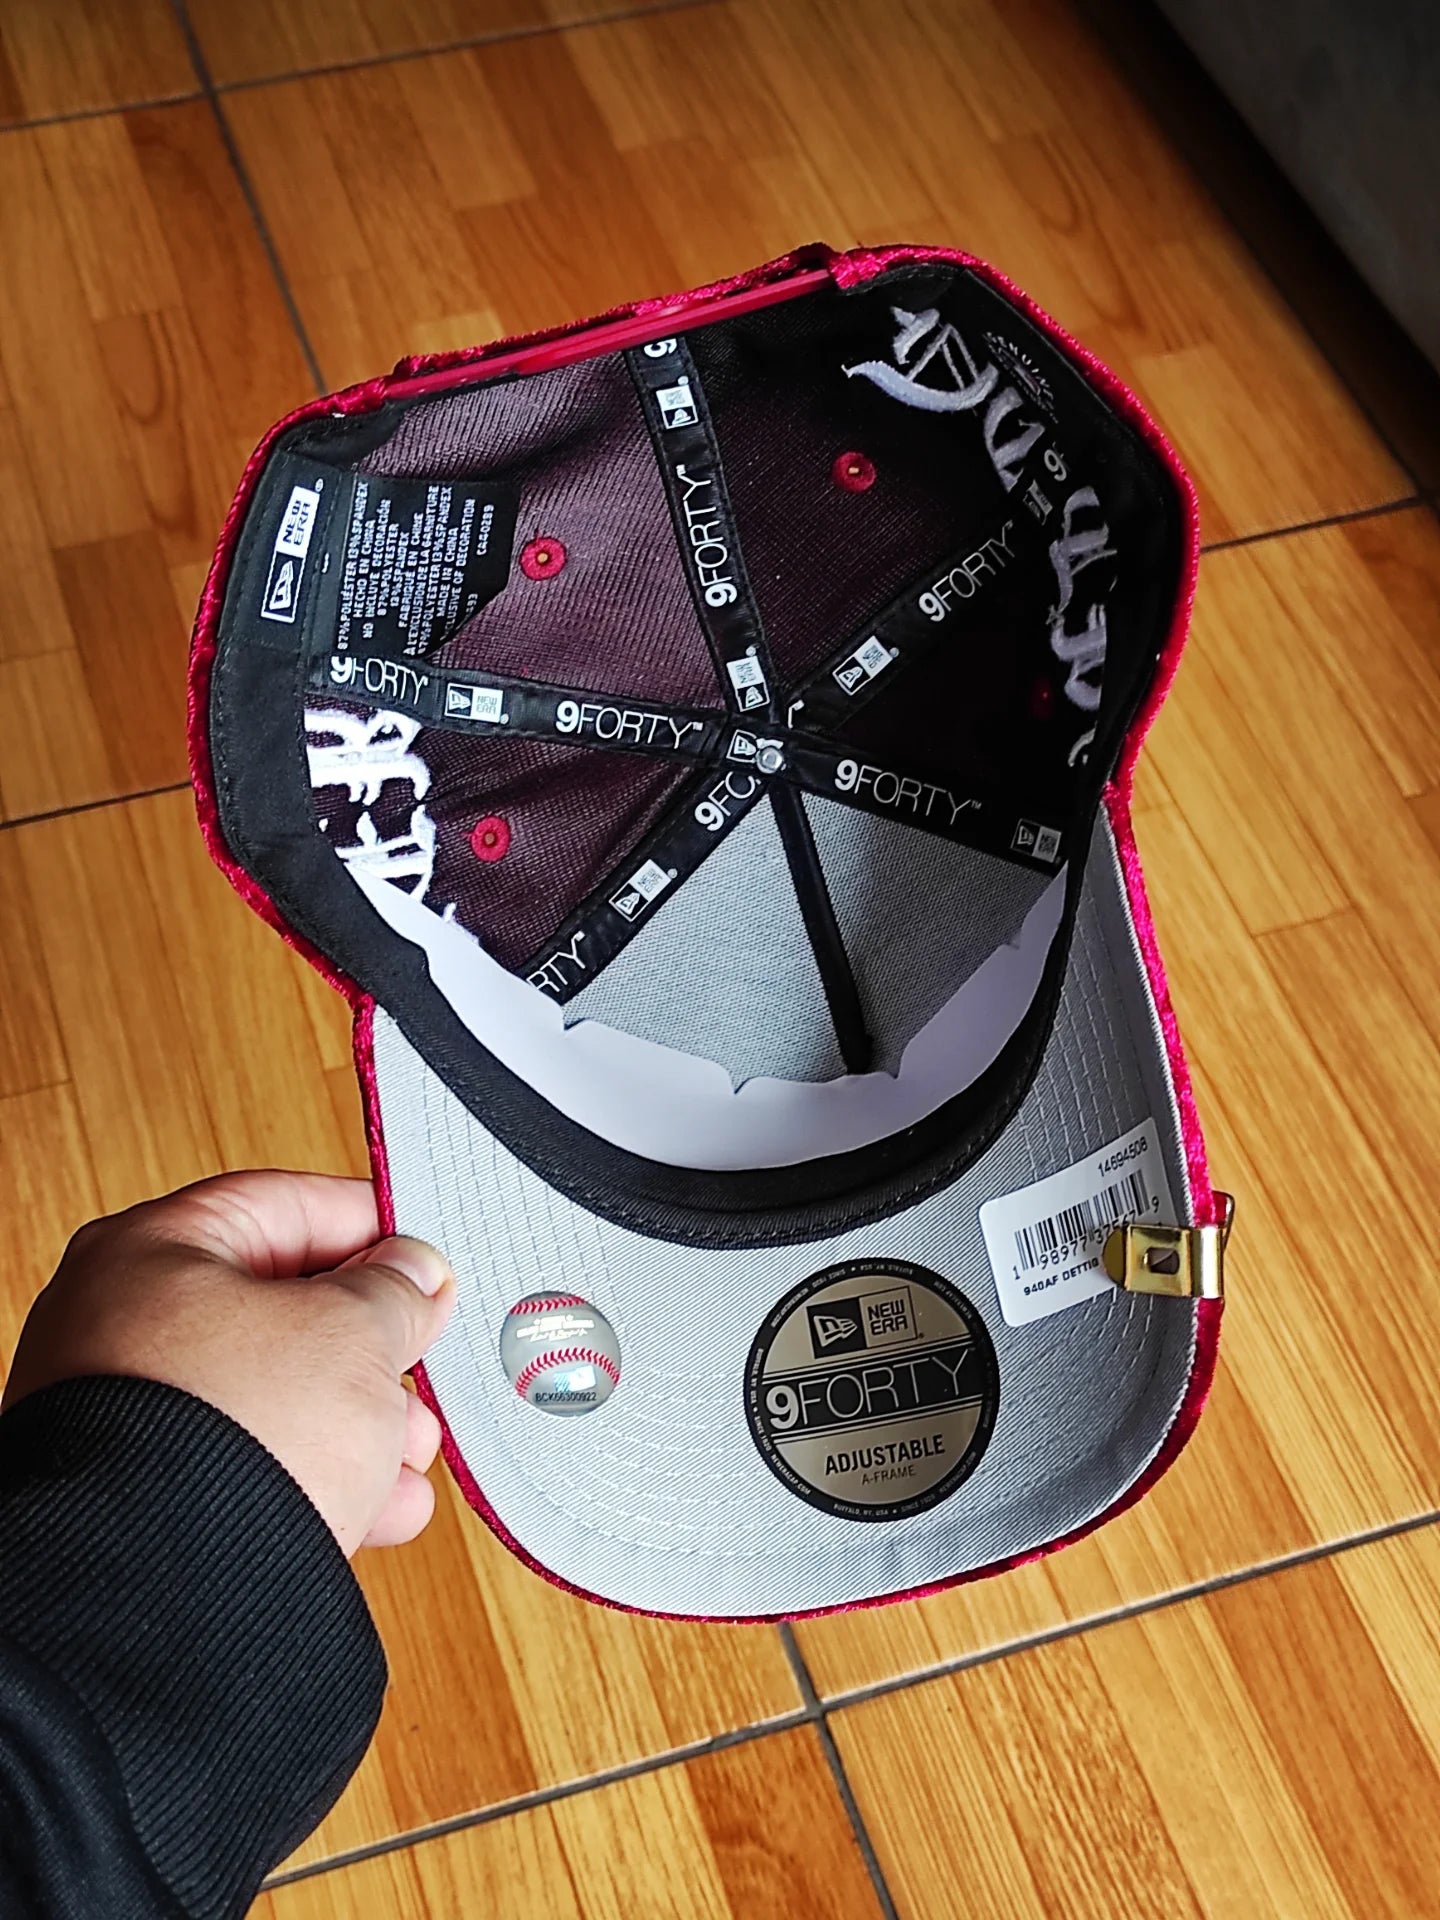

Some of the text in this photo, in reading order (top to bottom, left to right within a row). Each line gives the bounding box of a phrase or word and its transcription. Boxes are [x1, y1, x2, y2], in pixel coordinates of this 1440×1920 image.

[282, 498, 301, 543] NEW
[293, 502, 310, 545] ERA
[410, 512, 424, 545] CHINE
[421, 483, 439, 547] GARNITURE
[456, 498, 475, 566] DECORATION
[408, 549, 418, 566] EN
[419, 548, 430, 564] LA
[682, 475, 738, 608] 9FORTY
[352, 518, 375, 618] HECHO EN CHINA
[417, 566, 427, 580] DE
[436, 526, 458, 617] MADE IN CHINA
[453, 570, 464, 584] OF
[918, 526, 1015, 621] 9FORTY
[364, 571, 380, 617] INCLUYE
[362, 622, 373, 638] NO
[556, 701, 693, 749] 9FORTY
[834, 759, 972, 825] 9FORTY
[1097, 1136, 1149, 1177] 14694508
[1012, 1265, 1020, 1281] 1
[1040, 1239, 1088, 1270] 98977
[1151, 1196, 1160, 1214] 9
[1023, 1276, 1058, 1296] 940AF
[868, 1299, 907, 1321] NEW
[871, 1314, 909, 1336] ERA
[765, 1348, 969, 1430] 9FORTY
[825, 1434, 946, 1476] ADJUSTABLE
[862, 1465, 916, 1485] A-FRAME
